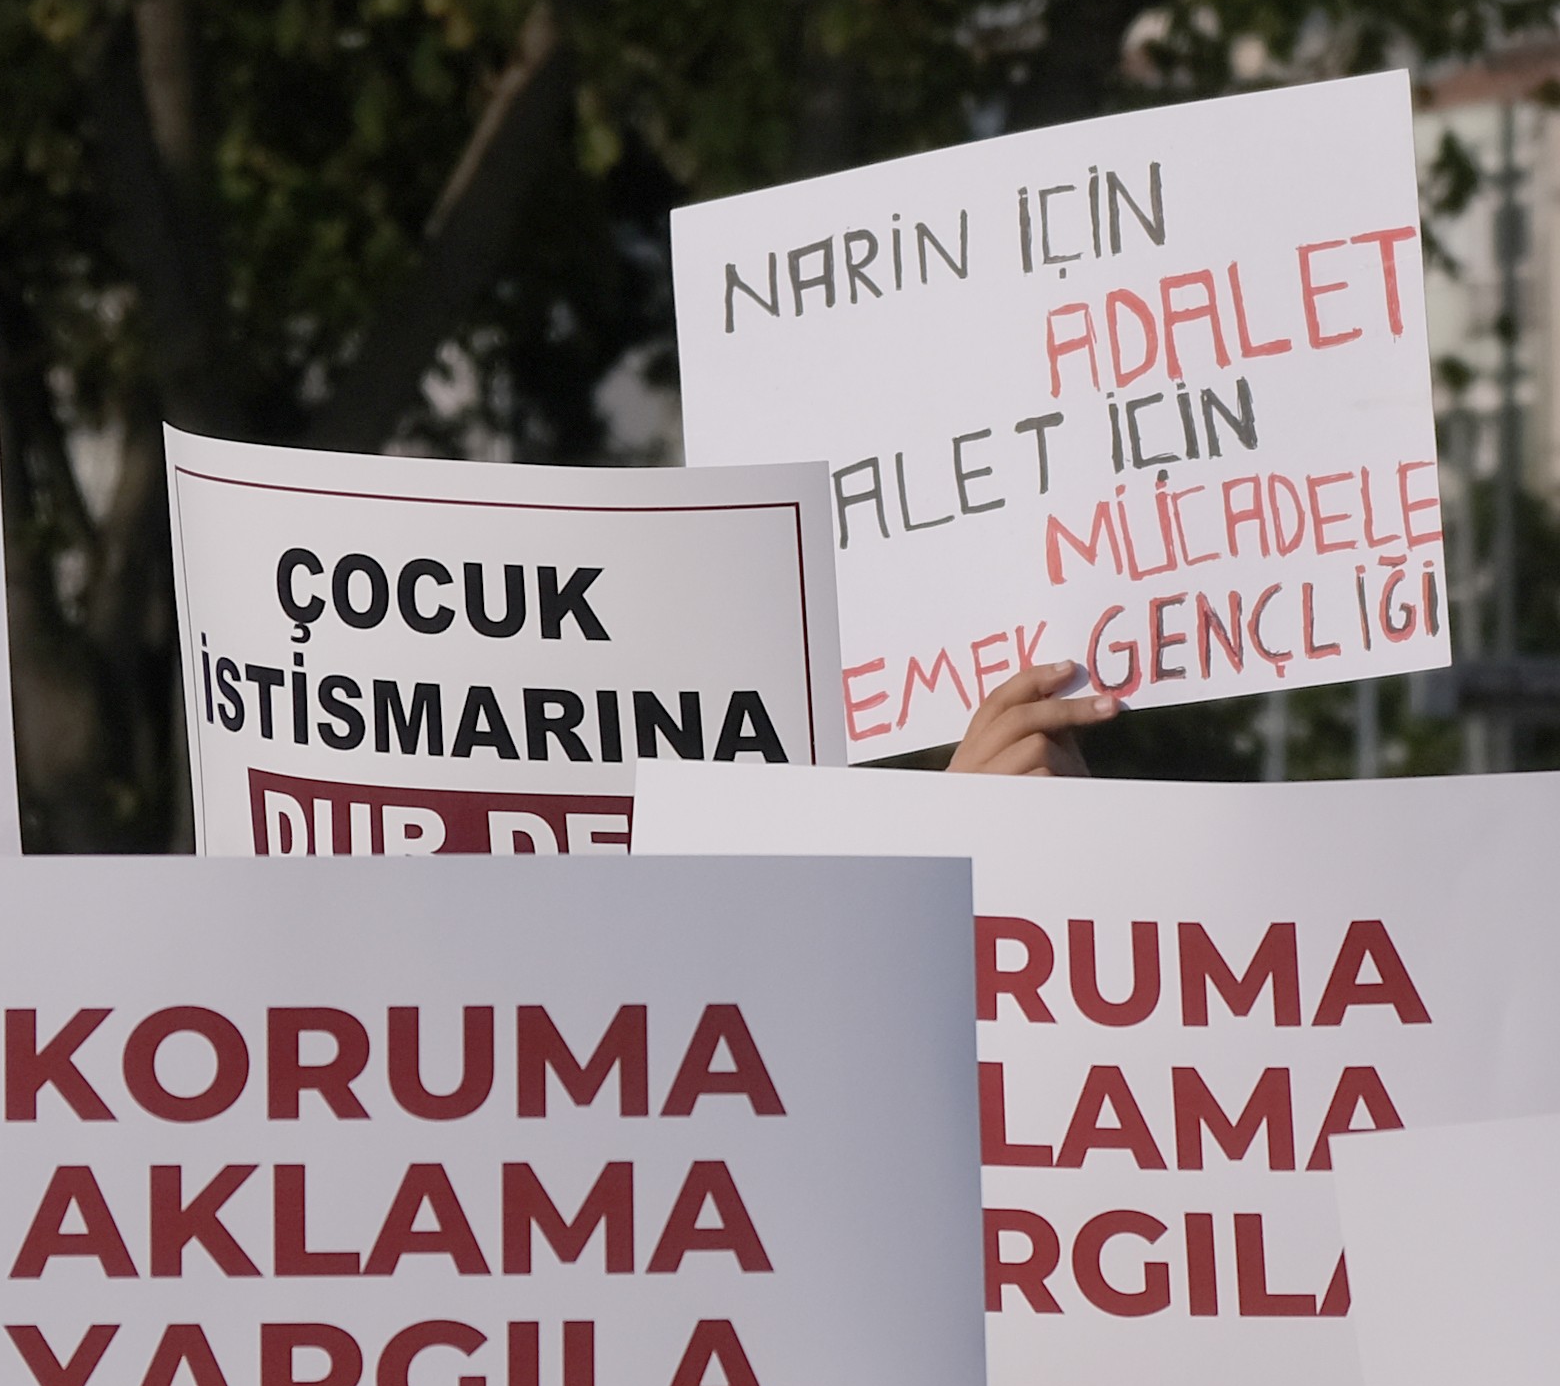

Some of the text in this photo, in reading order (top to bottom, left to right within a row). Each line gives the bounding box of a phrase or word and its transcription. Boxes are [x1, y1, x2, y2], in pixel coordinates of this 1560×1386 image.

[724, 162, 1166, 333] NARİN İÇİN
[1047, 226, 1417, 399] ADALET
[1108, 377, 1258, 483] İÇİN
[1046, 461, 1443, 585] MÜCADELE
[275, 547, 612, 644] ÇOCUK
[1086, 555, 1440, 700] GENÇLİĞİ
[200, 632, 790, 765] İSTİSMARINA
[973, 915, 1433, 1028] RUMA
[4, 1003, 788, 1124] KORUMA
[9, 1159, 775, 1280] AKLAMA
[982, 1209, 1351, 1318] RGIL
